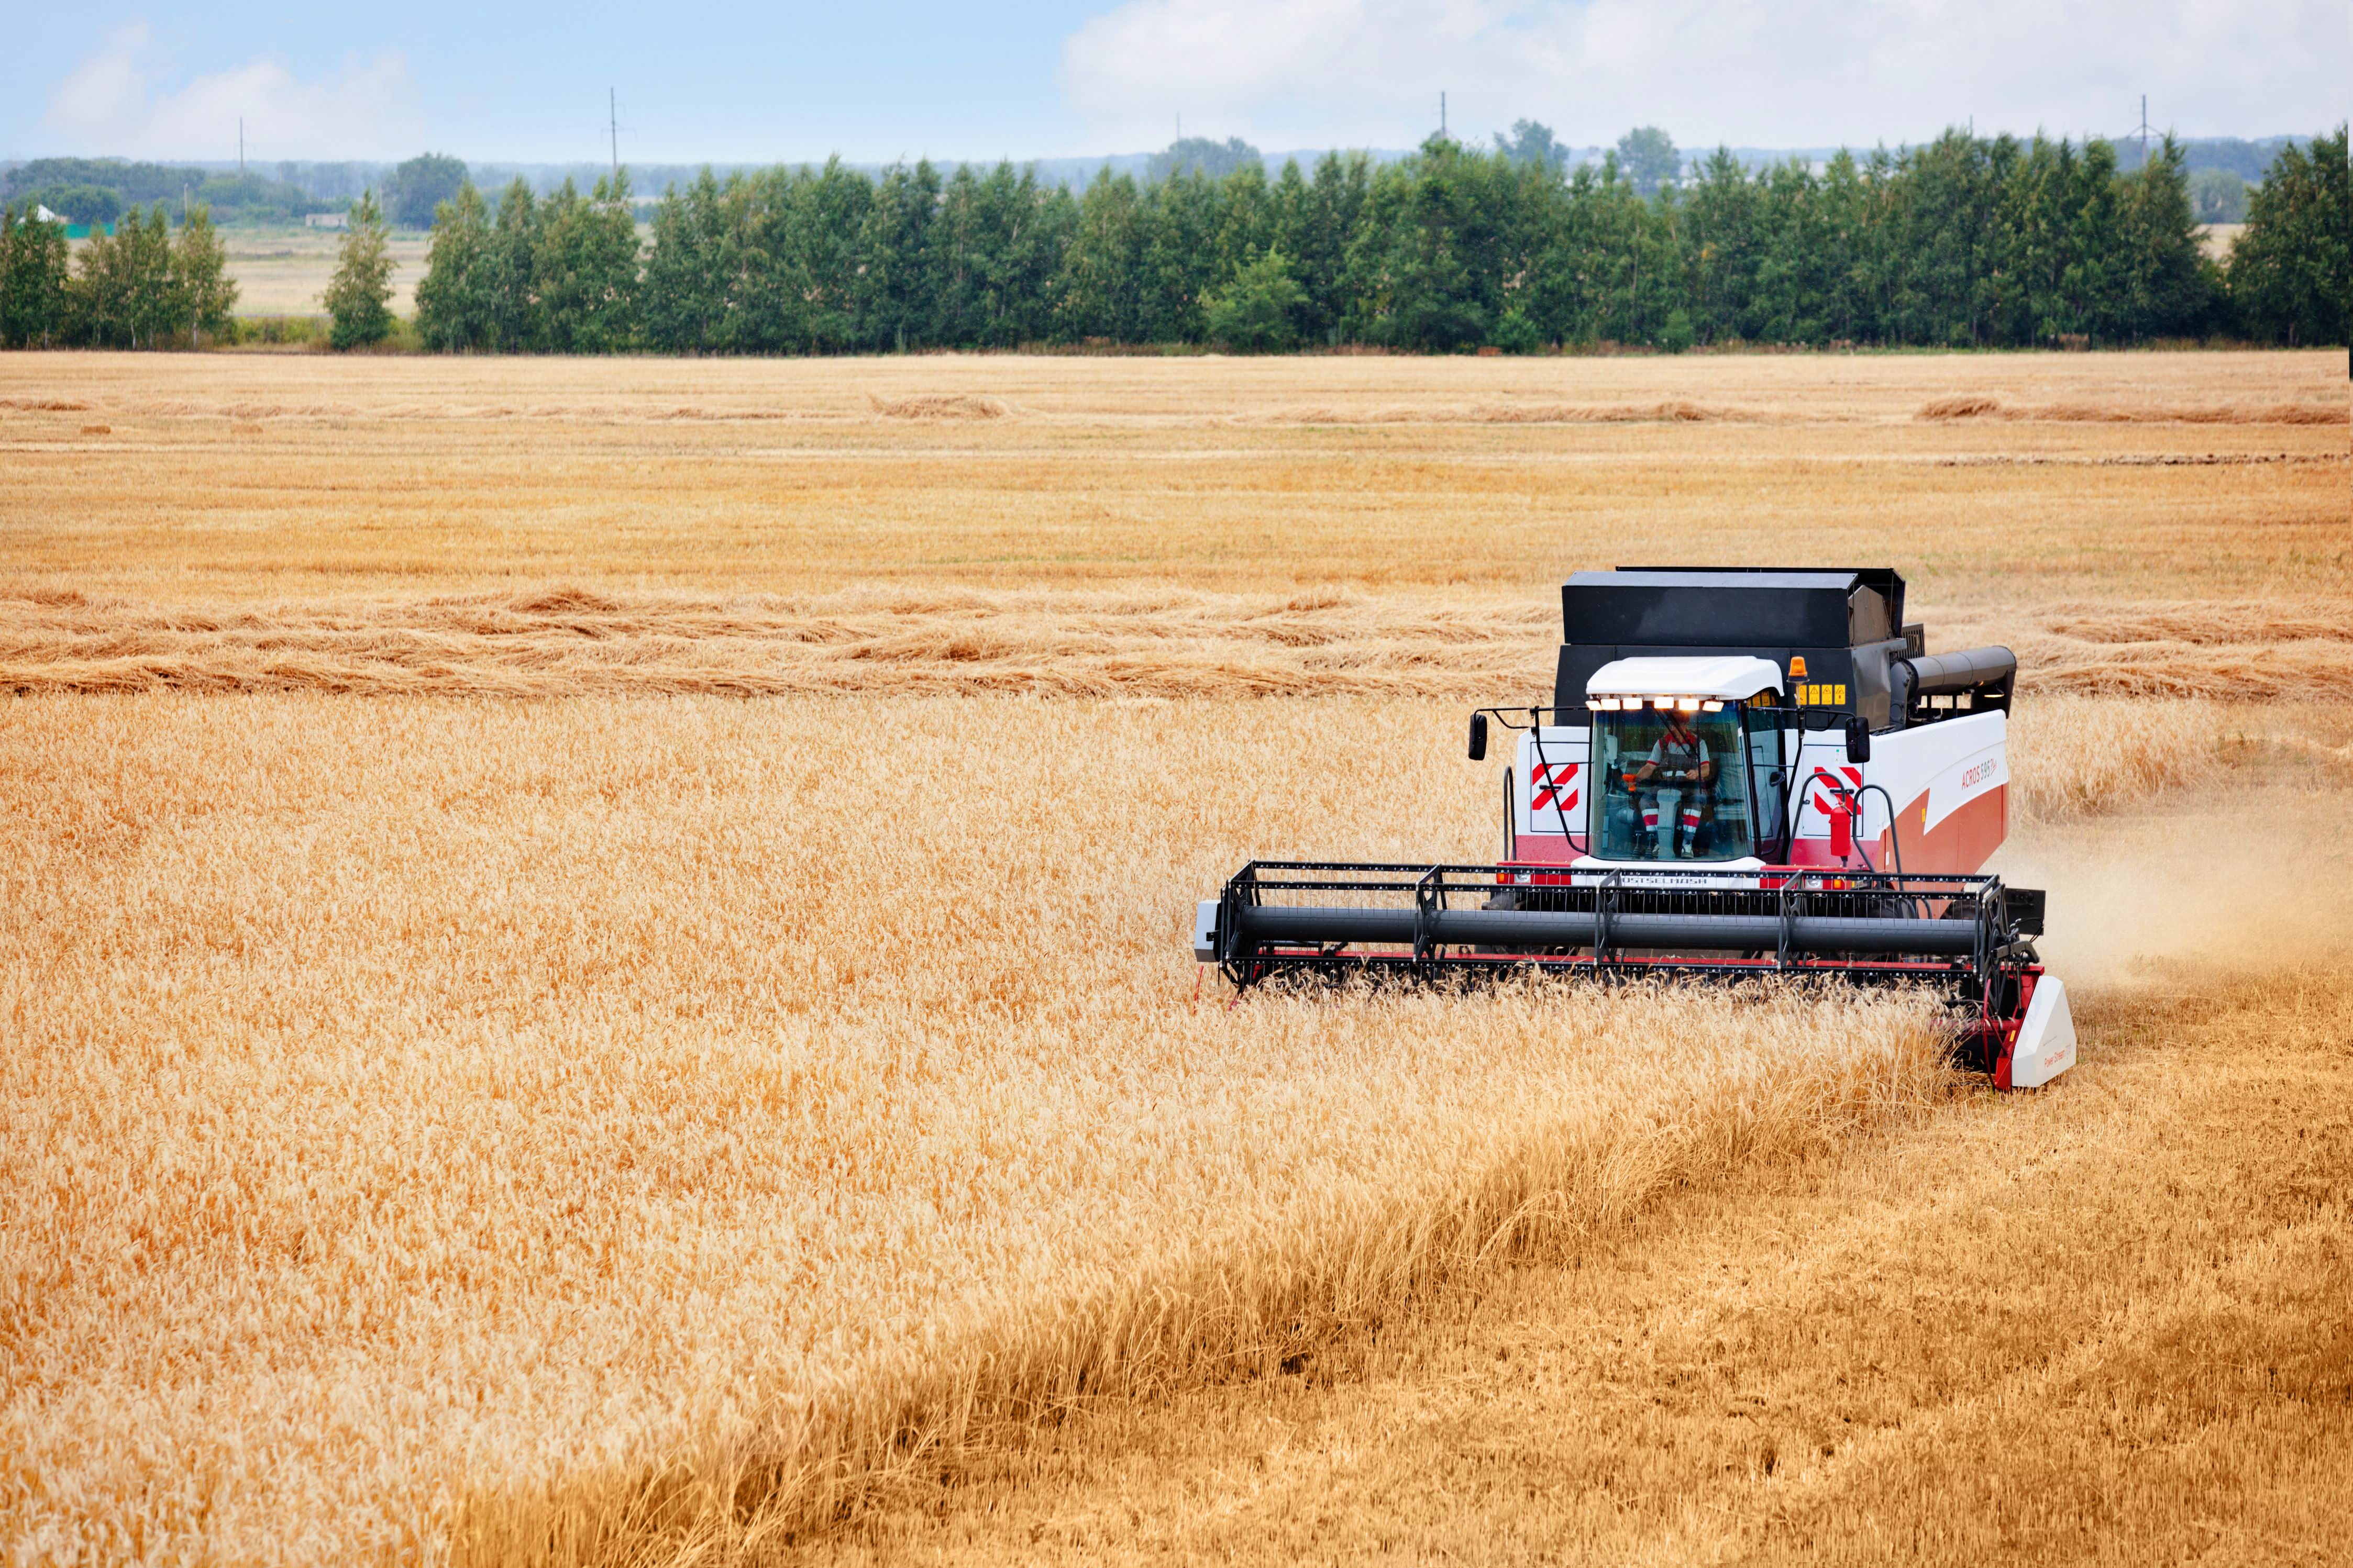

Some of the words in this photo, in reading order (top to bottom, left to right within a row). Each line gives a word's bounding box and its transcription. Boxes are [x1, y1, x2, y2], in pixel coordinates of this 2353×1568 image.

[1962, 765, 1980, 790] ACROS
[1981, 760, 1990, 781] 595
[2045, 1057, 2053, 1069] Power
